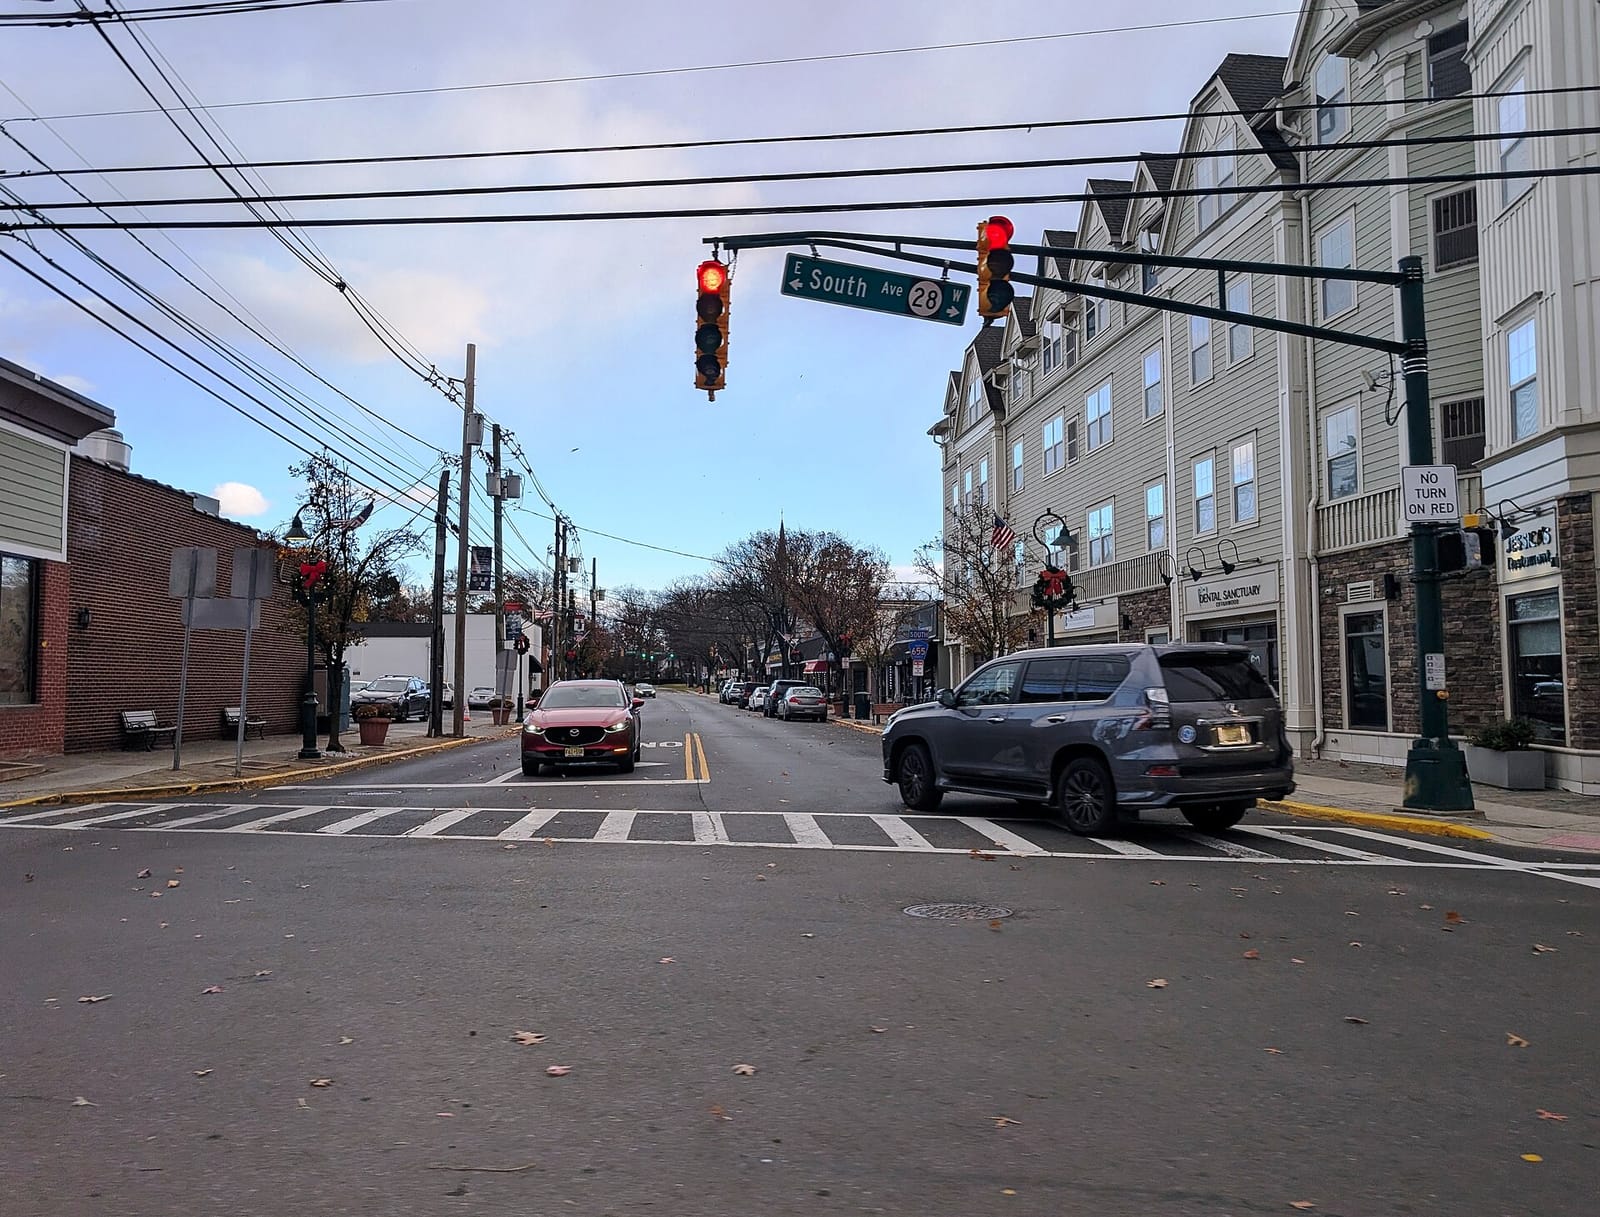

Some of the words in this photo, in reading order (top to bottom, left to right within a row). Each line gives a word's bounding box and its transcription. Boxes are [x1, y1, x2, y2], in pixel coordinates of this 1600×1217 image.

[794, 261, 803, 274] E
[809, 268, 867, 298] South
[881, 281, 903, 297] Ave
[911, 287, 938, 310] 28
[952, 288, 962, 302] W
[1420, 473, 1438, 484] NO
[1414, 488, 1446, 499] TURN
[1409, 503, 1425, 514] ON
[1431, 502, 1454, 514] RED
[1199, 591, 1221, 604] DENTAL
[1222, 585, 1261, 600] SANCTUARY
